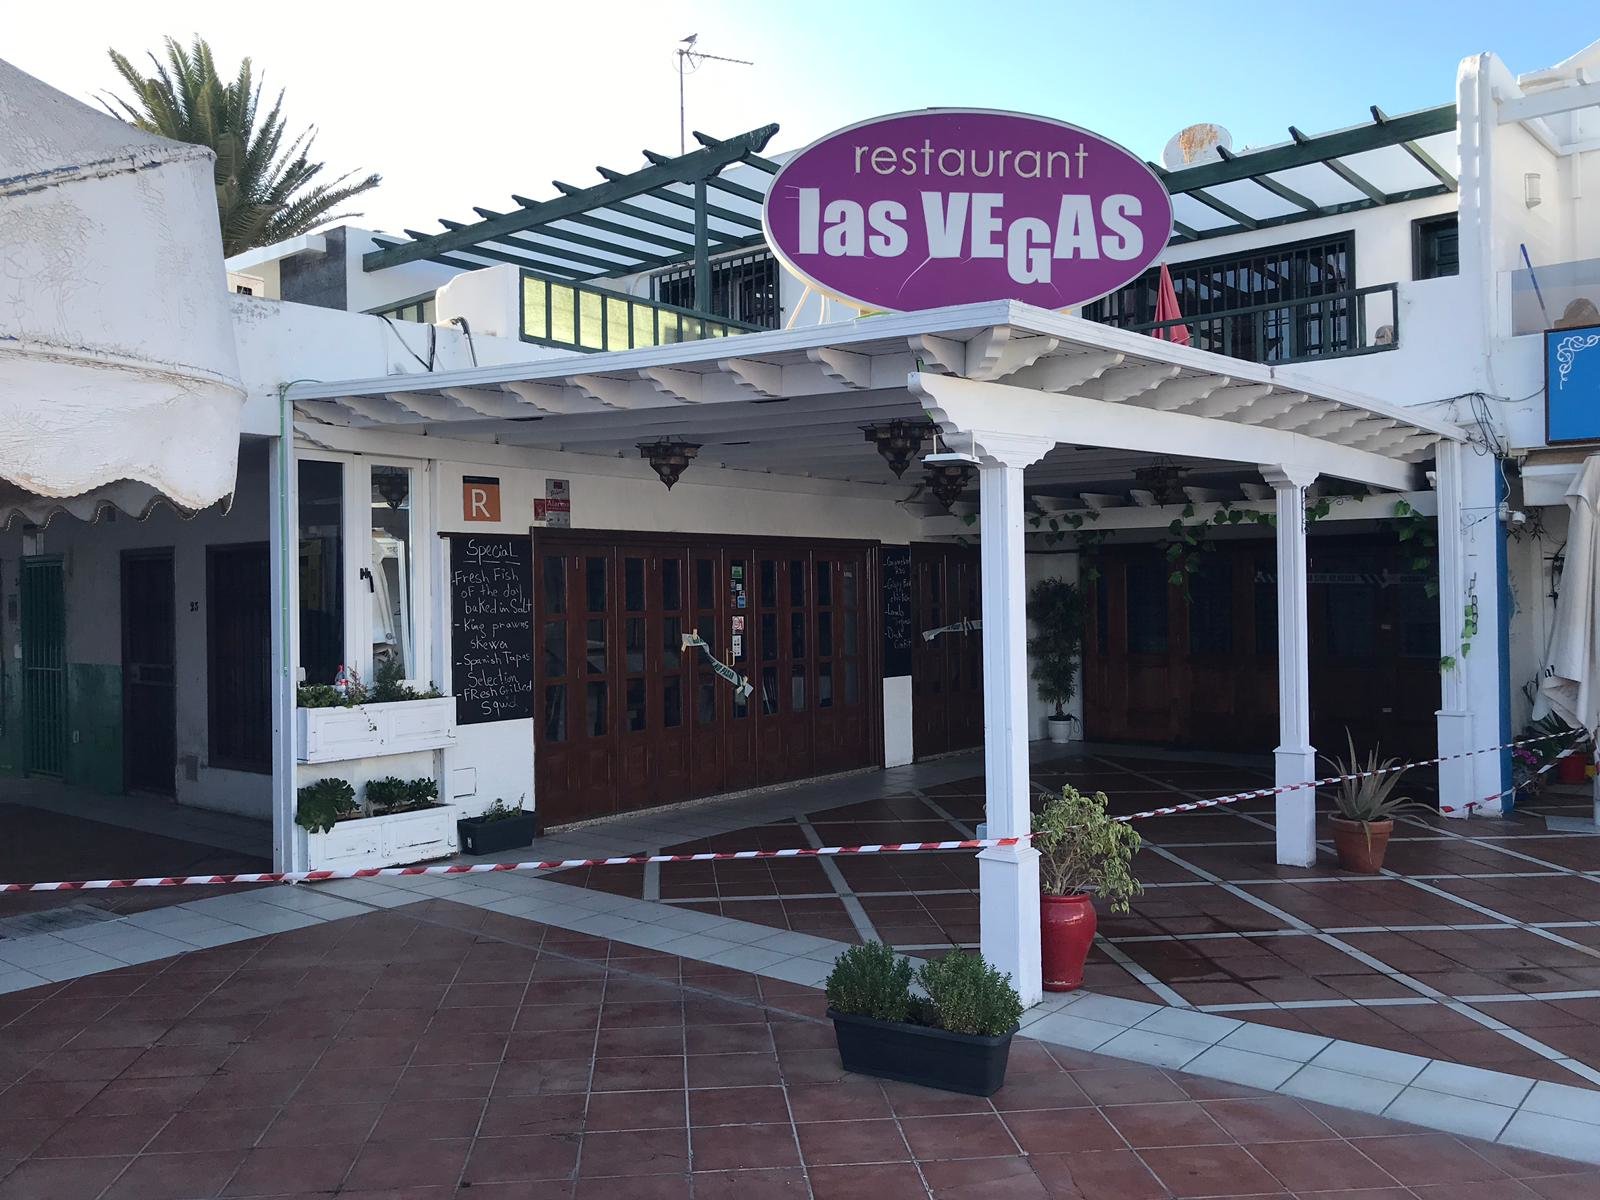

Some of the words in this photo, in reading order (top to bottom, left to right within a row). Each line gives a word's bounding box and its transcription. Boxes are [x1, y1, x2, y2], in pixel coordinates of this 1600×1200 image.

[854, 139, 1088, 179] restaurant
[799, 187, 908, 258] las
[920, 191, 1144, 285] VEGAS
[471, 488, 491, 518] R
[466, 538, 518, 566] Special
[454, 569, 490, 586] Fresh
[493, 567, 519, 582] Fish
[480, 584, 498, 597] the
[503, 583, 523, 604] day
[499, 601, 511, 613] in
[510, 597, 533, 614] Salt
[463, 617, 487, 639] King
[463, 652, 502, 672] Spanish
[501, 650, 530, 668] Tapas
[467, 667, 519, 688] Selection
